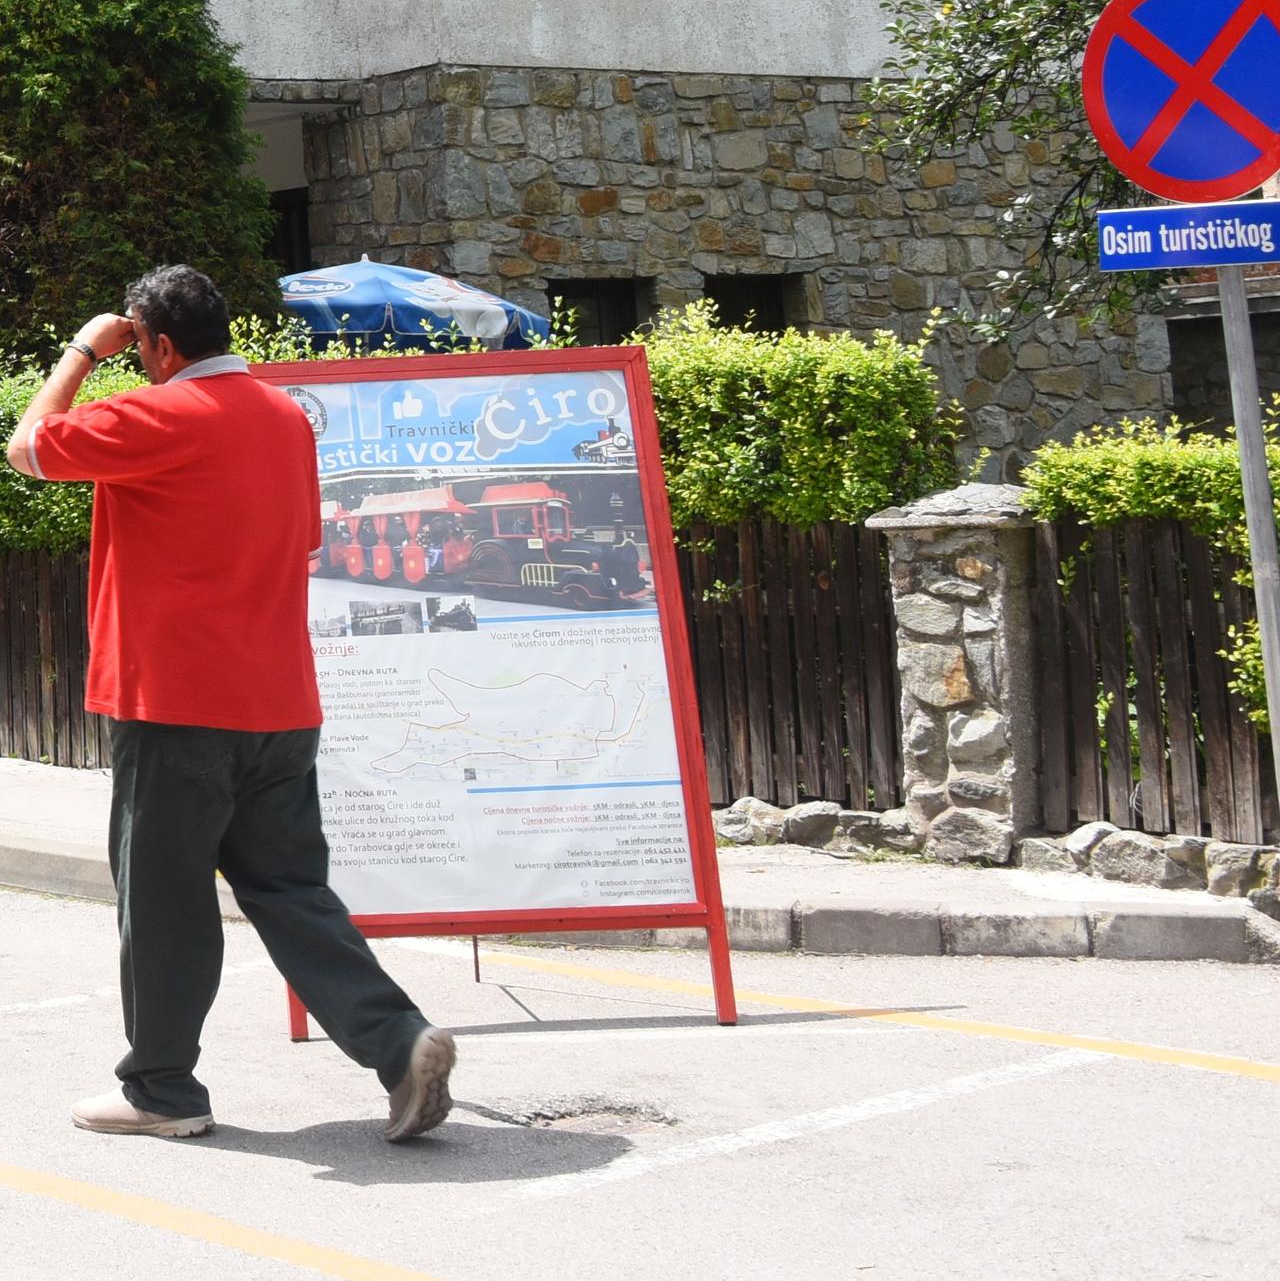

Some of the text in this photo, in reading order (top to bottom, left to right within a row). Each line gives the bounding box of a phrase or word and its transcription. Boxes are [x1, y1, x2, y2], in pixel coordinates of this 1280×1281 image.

[1103, 218, 1275, 256] Osim turističkog
[386, 420, 475, 439] Travnički
[406, 441, 476, 463] VOZ
[490, 631, 519, 640] Vozite
[511, 639, 548, 648] iskustvo
[557, 636, 594, 647] dnevnoj
[632, 633, 659, 644] vožnji
[312, 641, 359, 658] vožnje:
[360, 679, 383, 688] potom
[407, 699, 423, 708] grad
[330, 734, 349, 742] Plave
[350, 733, 369, 741] Vode
[334, 803, 343, 814] je
[344, 803, 356, 811] od
[358, 803, 385, 813] starog
[410, 800, 424, 809] ide
[345, 816, 365, 825] ulice
[366, 815, 378, 824] do
[380, 814, 416, 825] kružnog
[417, 813, 436, 823] toka
[438, 812, 454, 822] kod
[386, 827, 406, 839] grad
[408, 827, 446, 839] glavnom
[335, 843, 347, 853] do
[348, 841, 393, 853] Tarabovca
[394, 840, 414, 854] gdje
[630, 836, 673, 845] informacije
[567, 849, 592, 857] Telefon
[343, 857, 366, 867] svoju
[368, 856, 399, 865] stanicu
[401, 854, 417, 864] kod
[419, 854, 447, 866] starog
[514, 861, 552, 870] Marketing:
